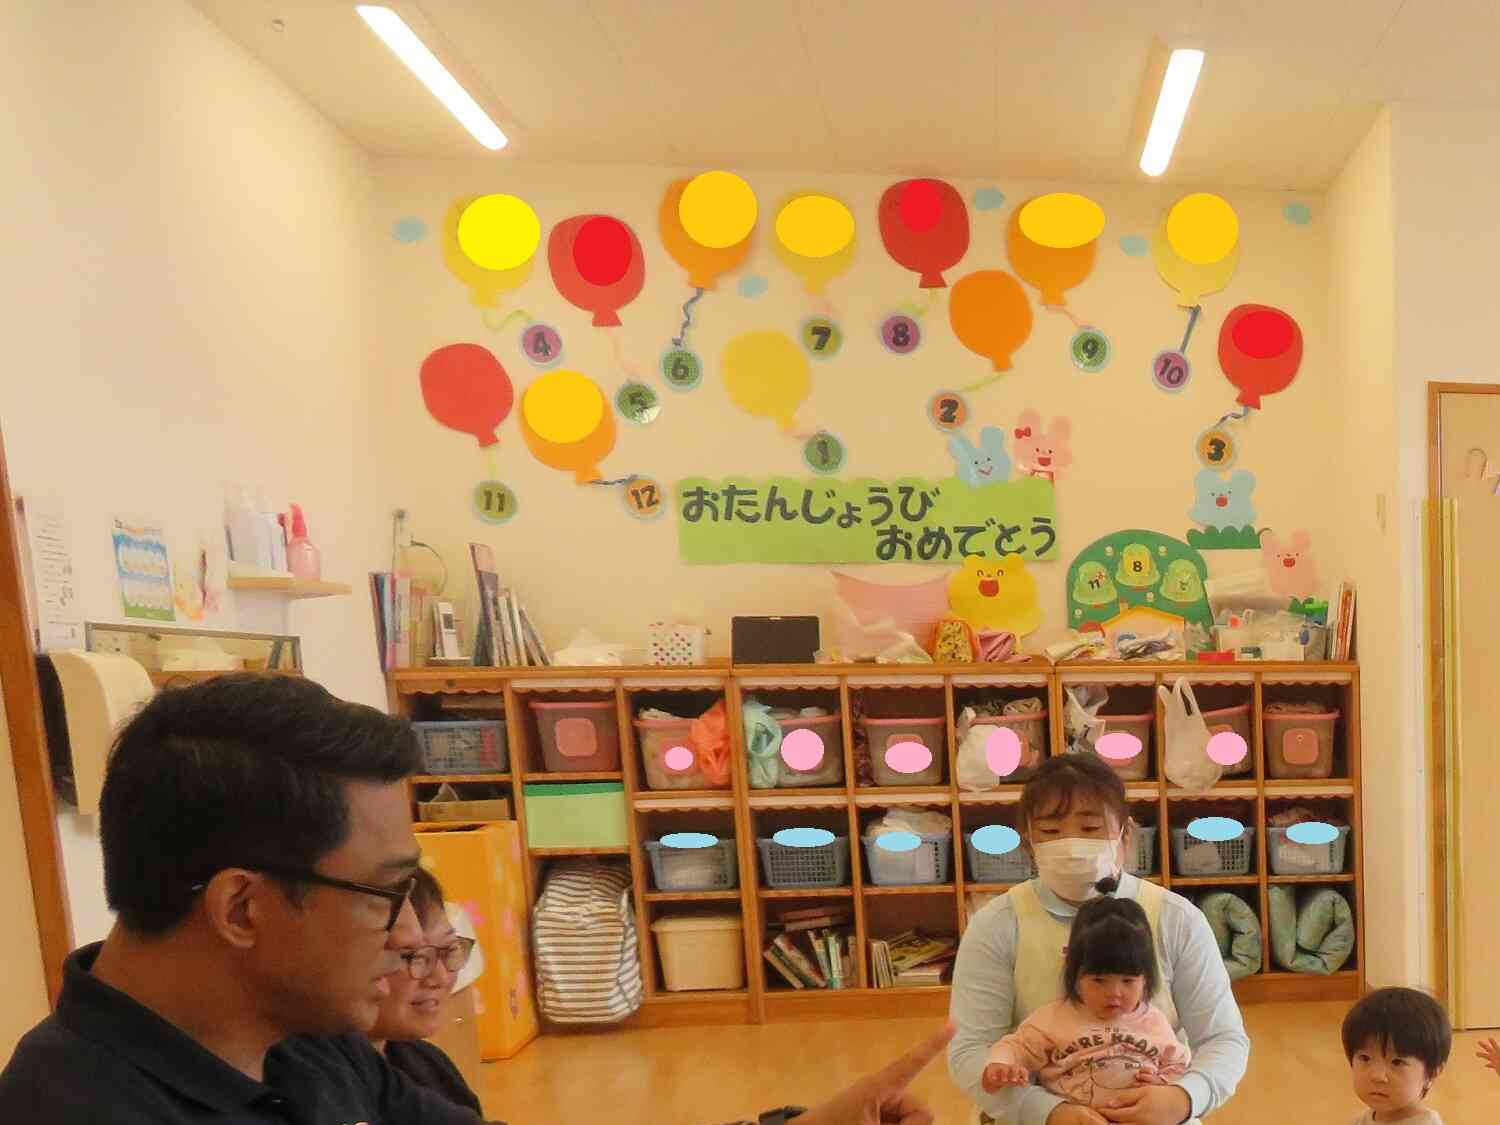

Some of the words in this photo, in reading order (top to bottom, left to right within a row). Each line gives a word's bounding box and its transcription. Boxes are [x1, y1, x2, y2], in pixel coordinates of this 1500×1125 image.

[533, 331, 551, 357] 4
[811, 326, 832, 350] 7
[892, 322, 911, 347] 8
[1082, 337, 1099, 359] 9
[671, 357, 689, 380] 6
[1159, 358, 1184, 385] 10
[939, 399, 959, 423] 2
[1207, 438, 1226, 461] 3
[484, 489, 505, 512] 11
[631, 485, 660, 509] 12
[682, 484, 940, 529] おたんじょうび
[875, 517, 1056, 561] おめでとう
[1132, 560, 1143, 572] 8
